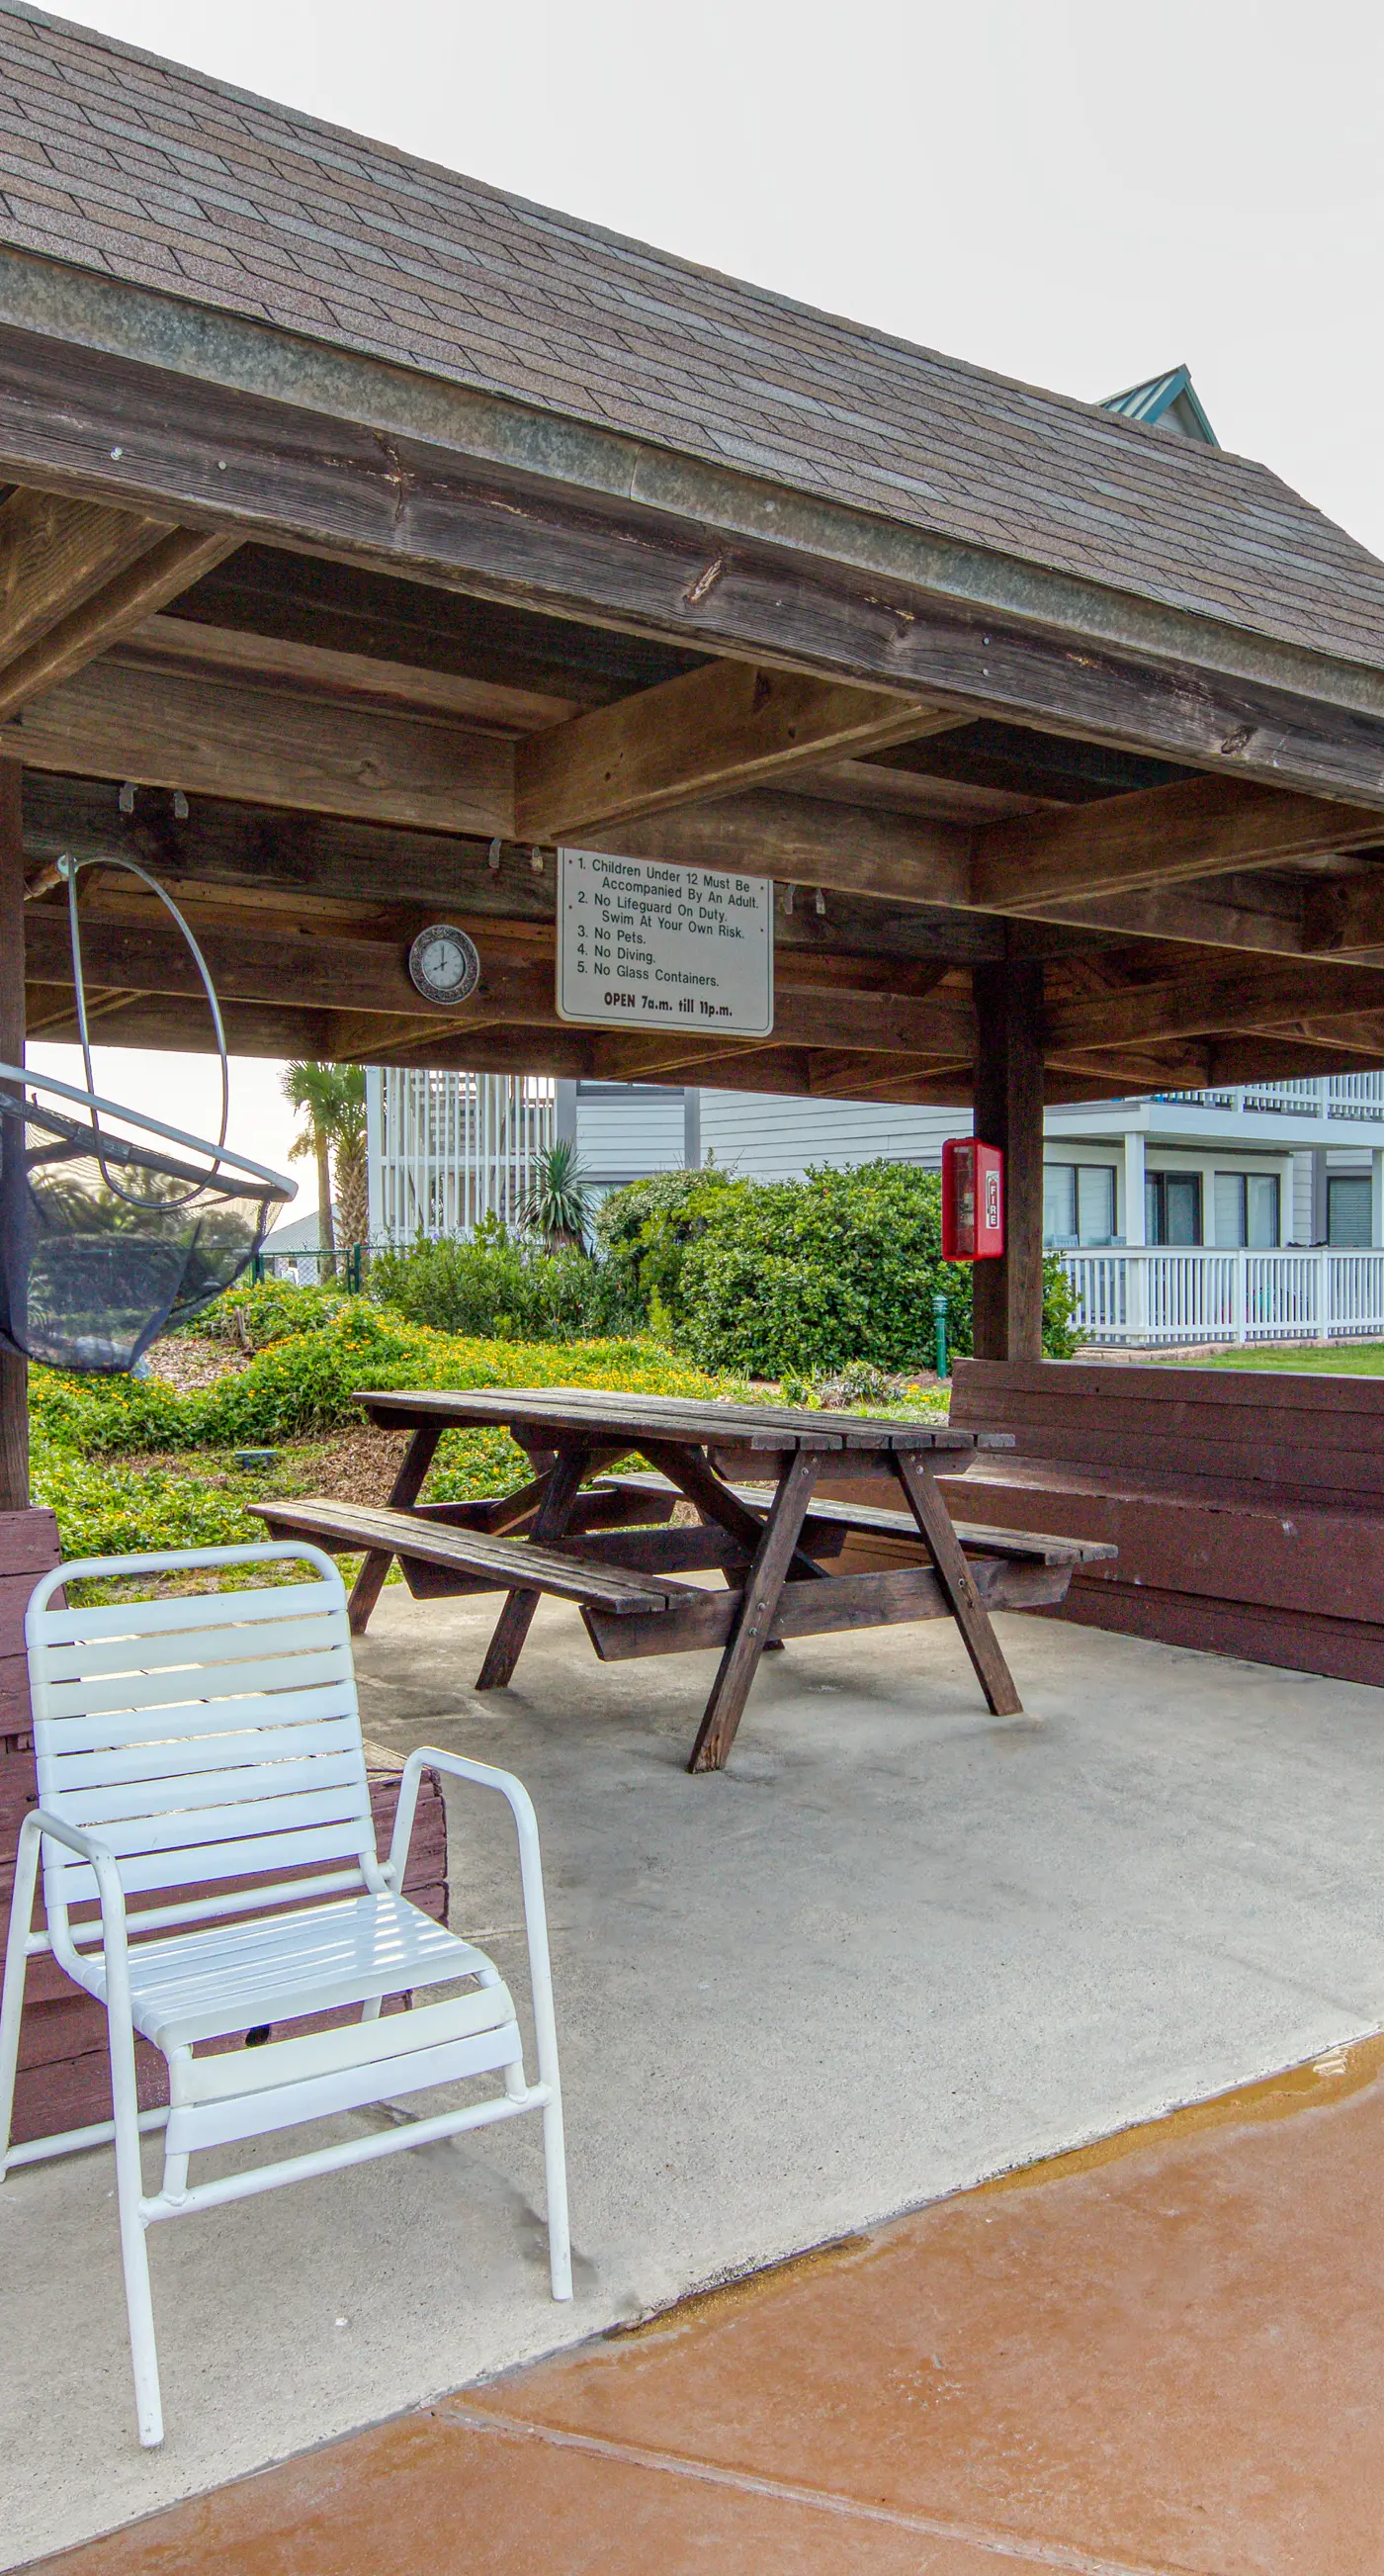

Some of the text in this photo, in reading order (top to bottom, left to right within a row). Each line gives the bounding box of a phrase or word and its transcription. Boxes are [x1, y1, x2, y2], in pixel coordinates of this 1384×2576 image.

[577, 858, 750, 892] 1. Children Under 12 Must Be
[602, 877, 758, 909] Accompanied By An Adult.
[577, 892, 727, 922] 2. No Lifeguard On Duty.
[577, 926, 646, 943] 3. No Pets.
[602, 911, 744, 938] Swim At Your Own Risk.
[577, 943, 655, 964] 4. No Diving.
[577, 961, 719, 986] 5. No Glass Containers.
[605, 992, 733, 1018] OPEN 7a.m. till 11p.m.
